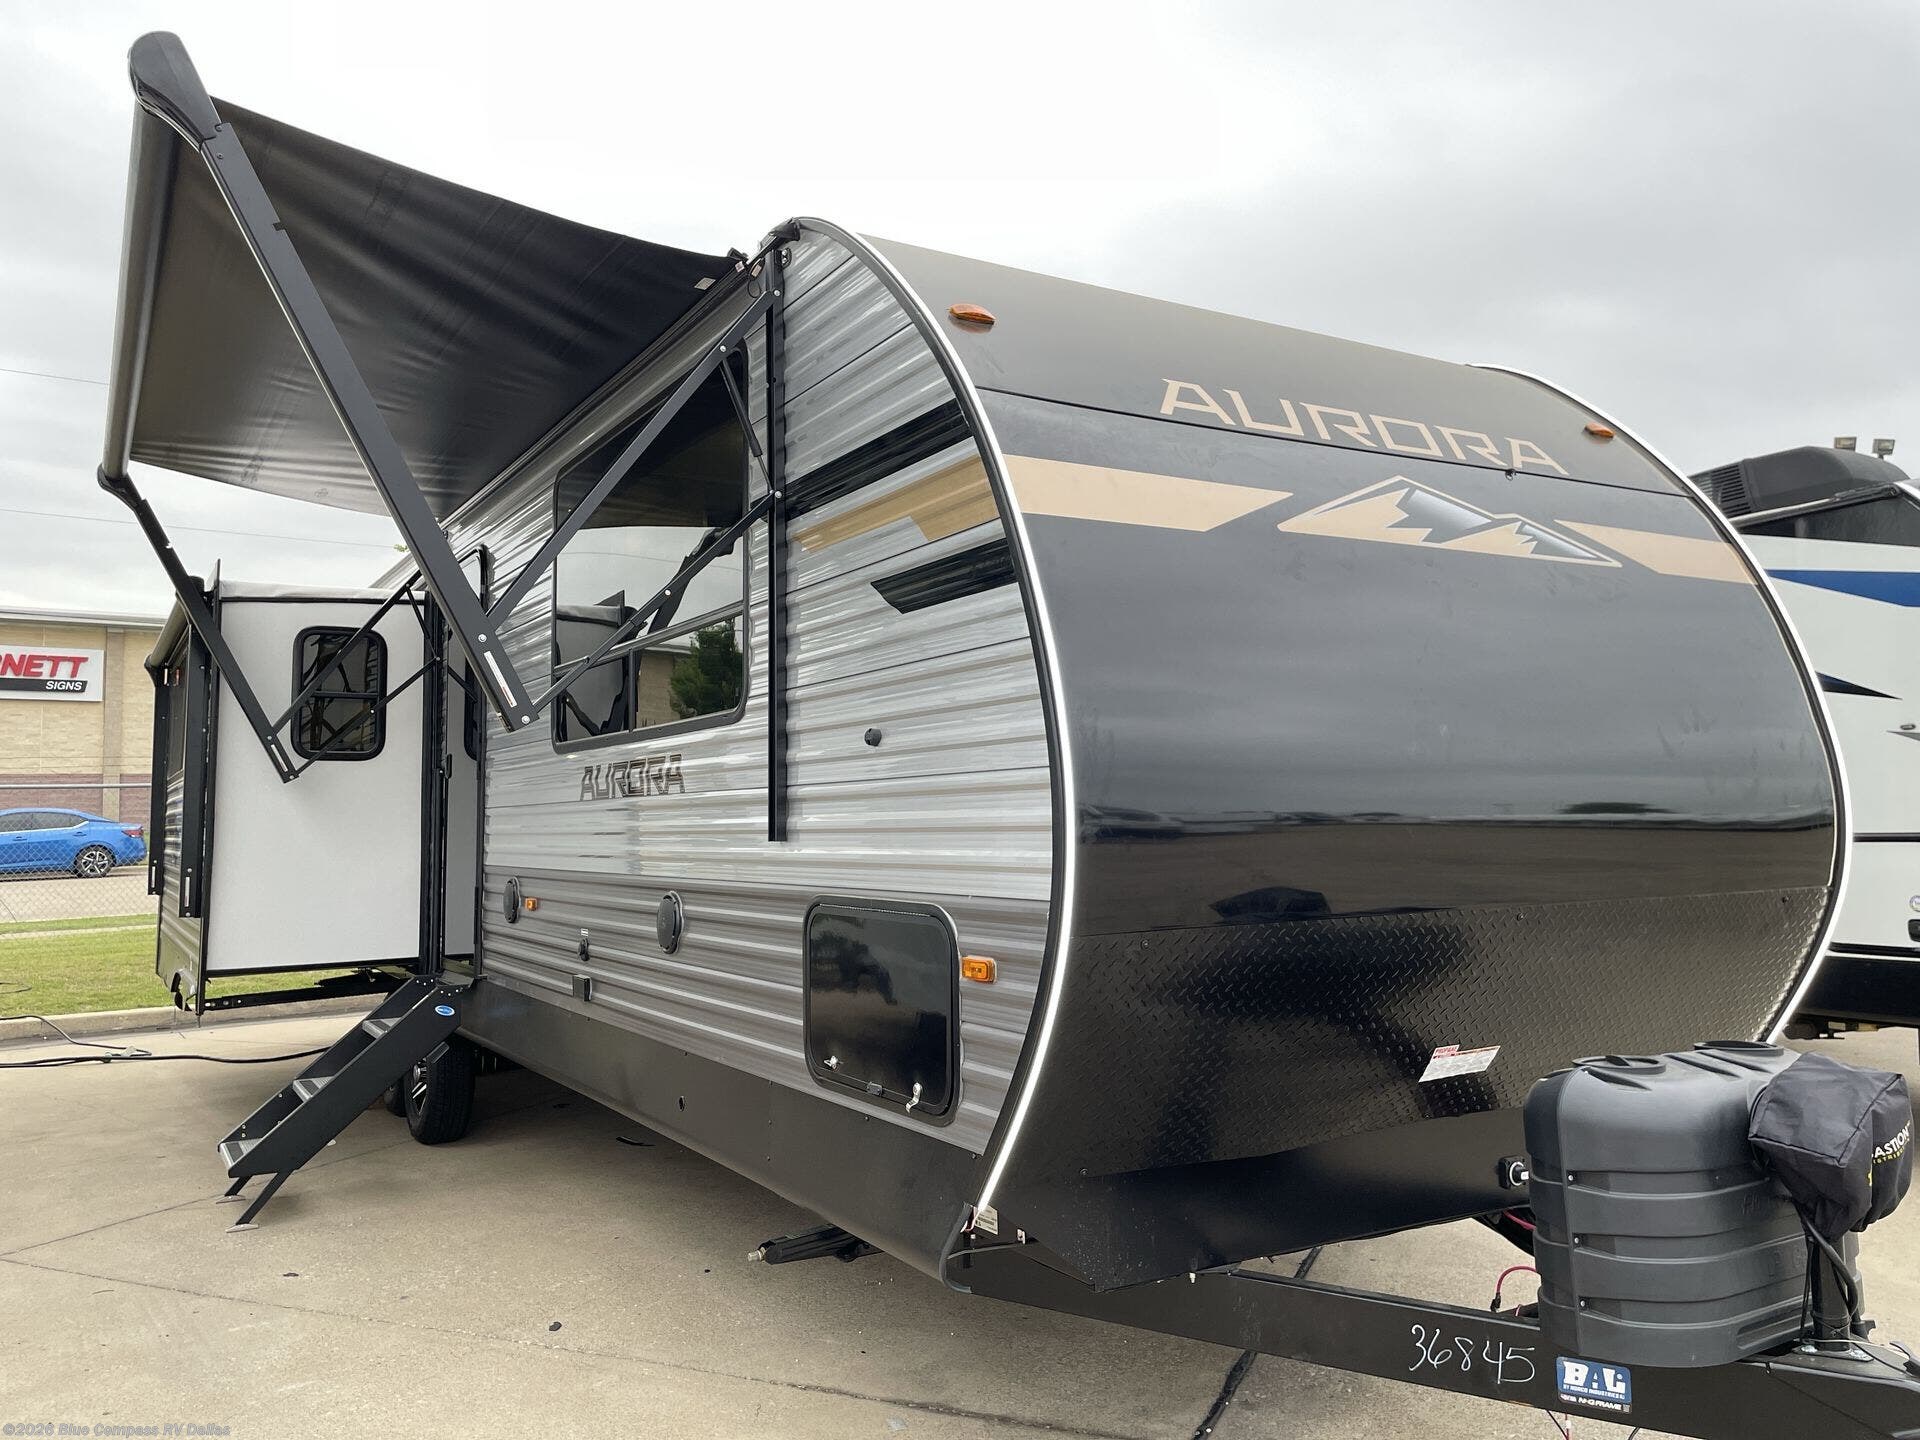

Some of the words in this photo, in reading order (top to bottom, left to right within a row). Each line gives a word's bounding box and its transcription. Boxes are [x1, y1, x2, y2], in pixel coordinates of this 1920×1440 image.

[1159, 378, 1569, 476] AURORA
[0, 653, 89, 678] NETT
[45, 680, 83, 691] SIGNS
[580, 753, 686, 801] AURORA
[1872, 1125, 1909, 1158] ASTION
[1409, 1324, 1536, 1385] 36845
[1563, 1361, 1626, 1393] BAL
